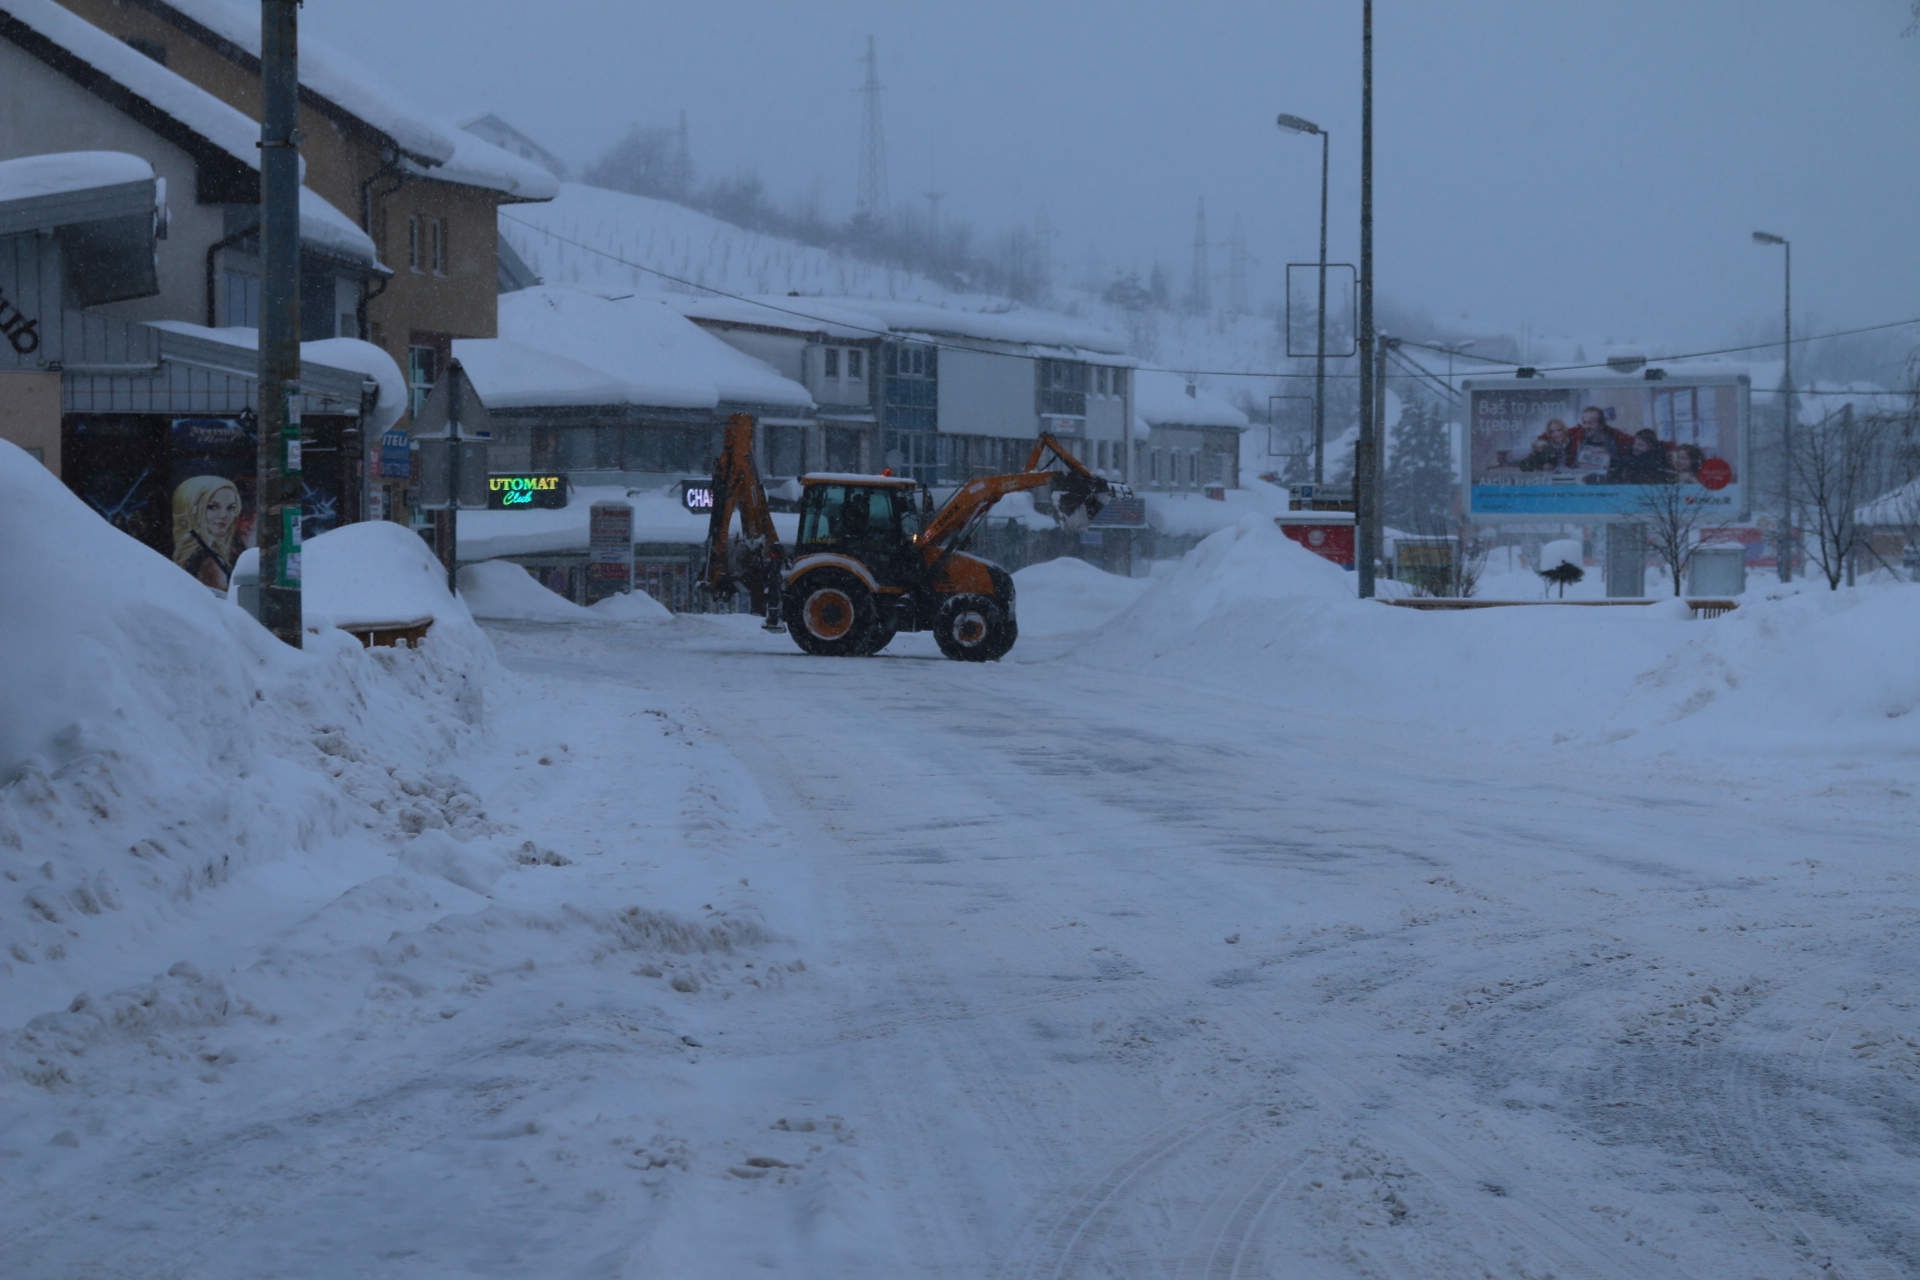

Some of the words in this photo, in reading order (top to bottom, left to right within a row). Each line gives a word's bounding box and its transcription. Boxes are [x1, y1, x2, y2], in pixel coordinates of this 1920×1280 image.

[0, 286, 39, 354] ub
[1479, 399, 1507, 415] Baš
[1511, 401, 1527, 415] to
[1532, 401, 1567, 414] nam
[489, 477, 559, 491] UTOMAT
[503, 490, 534, 505] Club
[687, 488, 714, 507] CHA
[932, 503, 961, 531] TEREX
